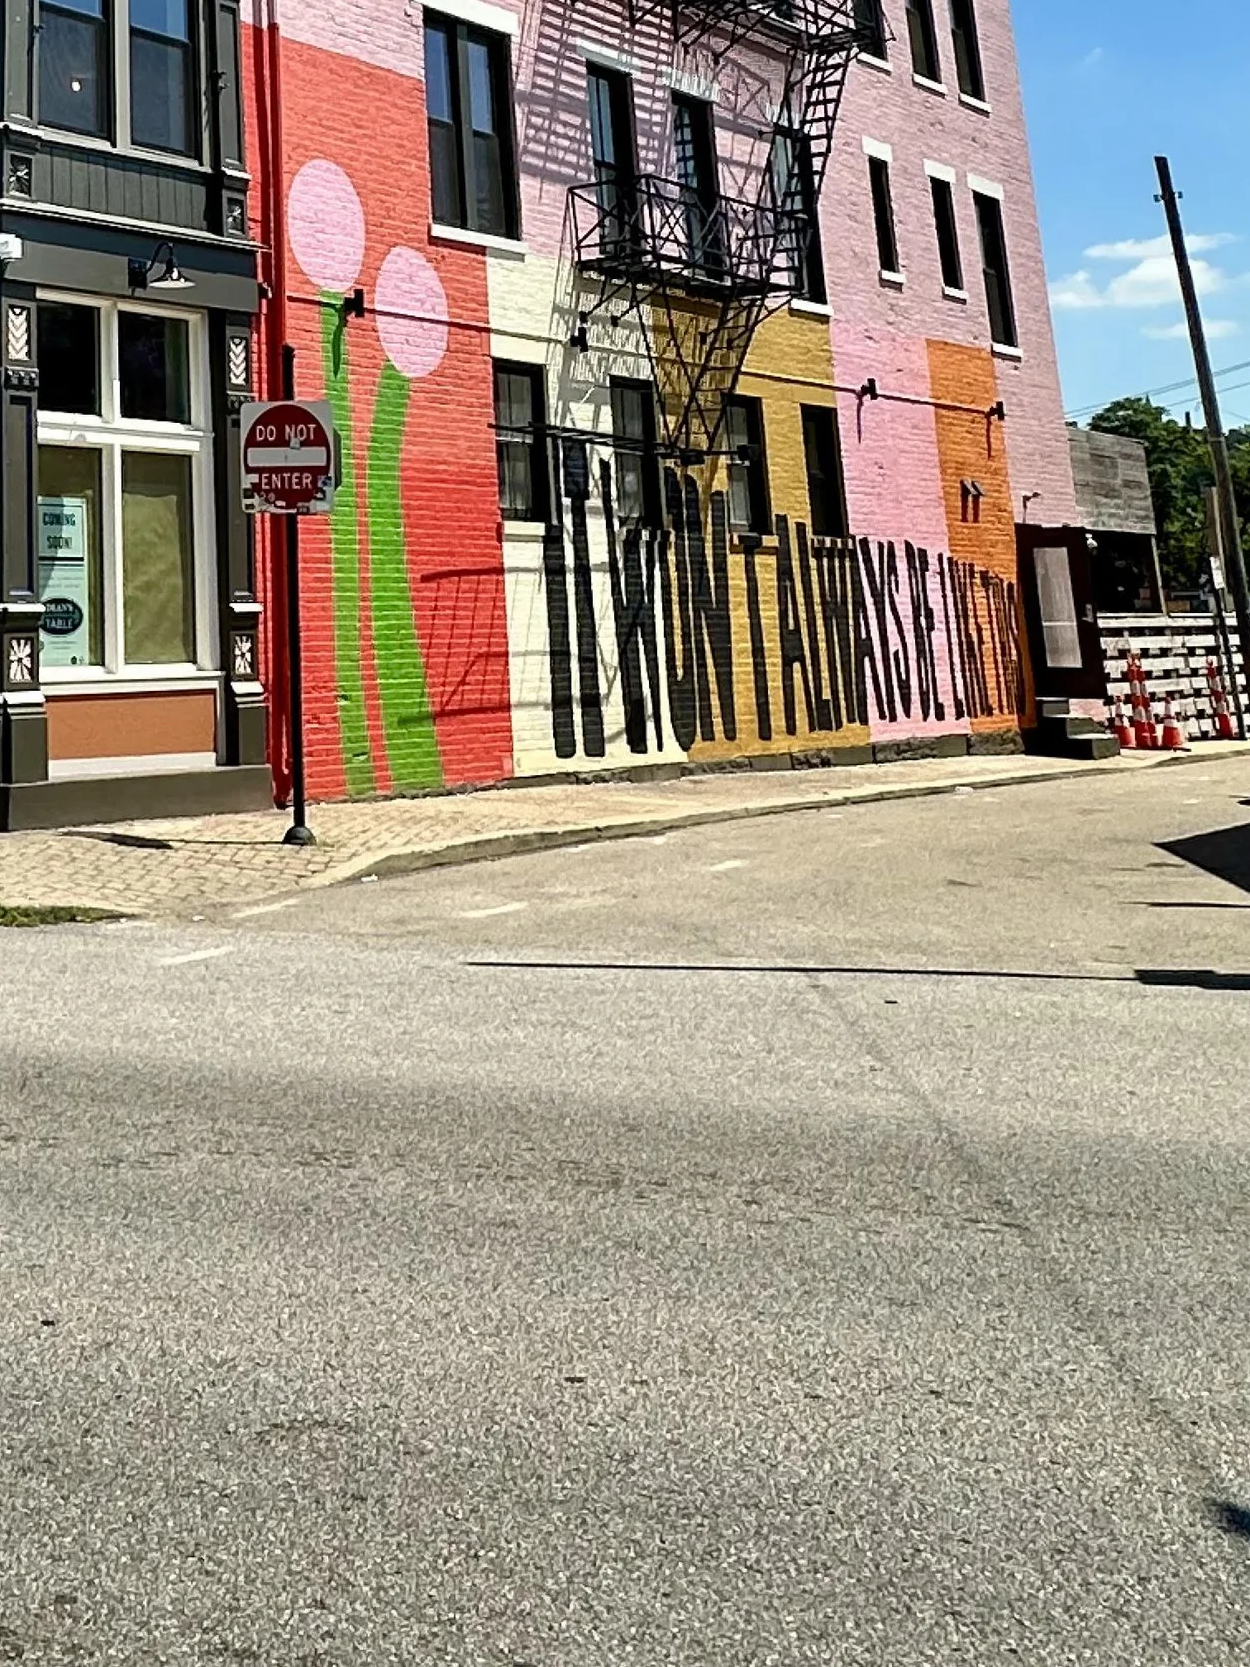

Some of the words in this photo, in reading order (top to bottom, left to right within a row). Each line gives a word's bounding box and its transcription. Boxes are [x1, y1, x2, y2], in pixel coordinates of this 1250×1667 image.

[256, 425, 277, 442] DO
[285, 424, 317, 441] NOT
[261, 472, 312, 490] ENTER
[43, 512, 76, 526] COMING
[45, 617, 74, 629] TABLE
[775, 513, 911, 736] ALWAYS
[904, 539, 945, 722] BE
[937, 552, 994, 722] LIKE
